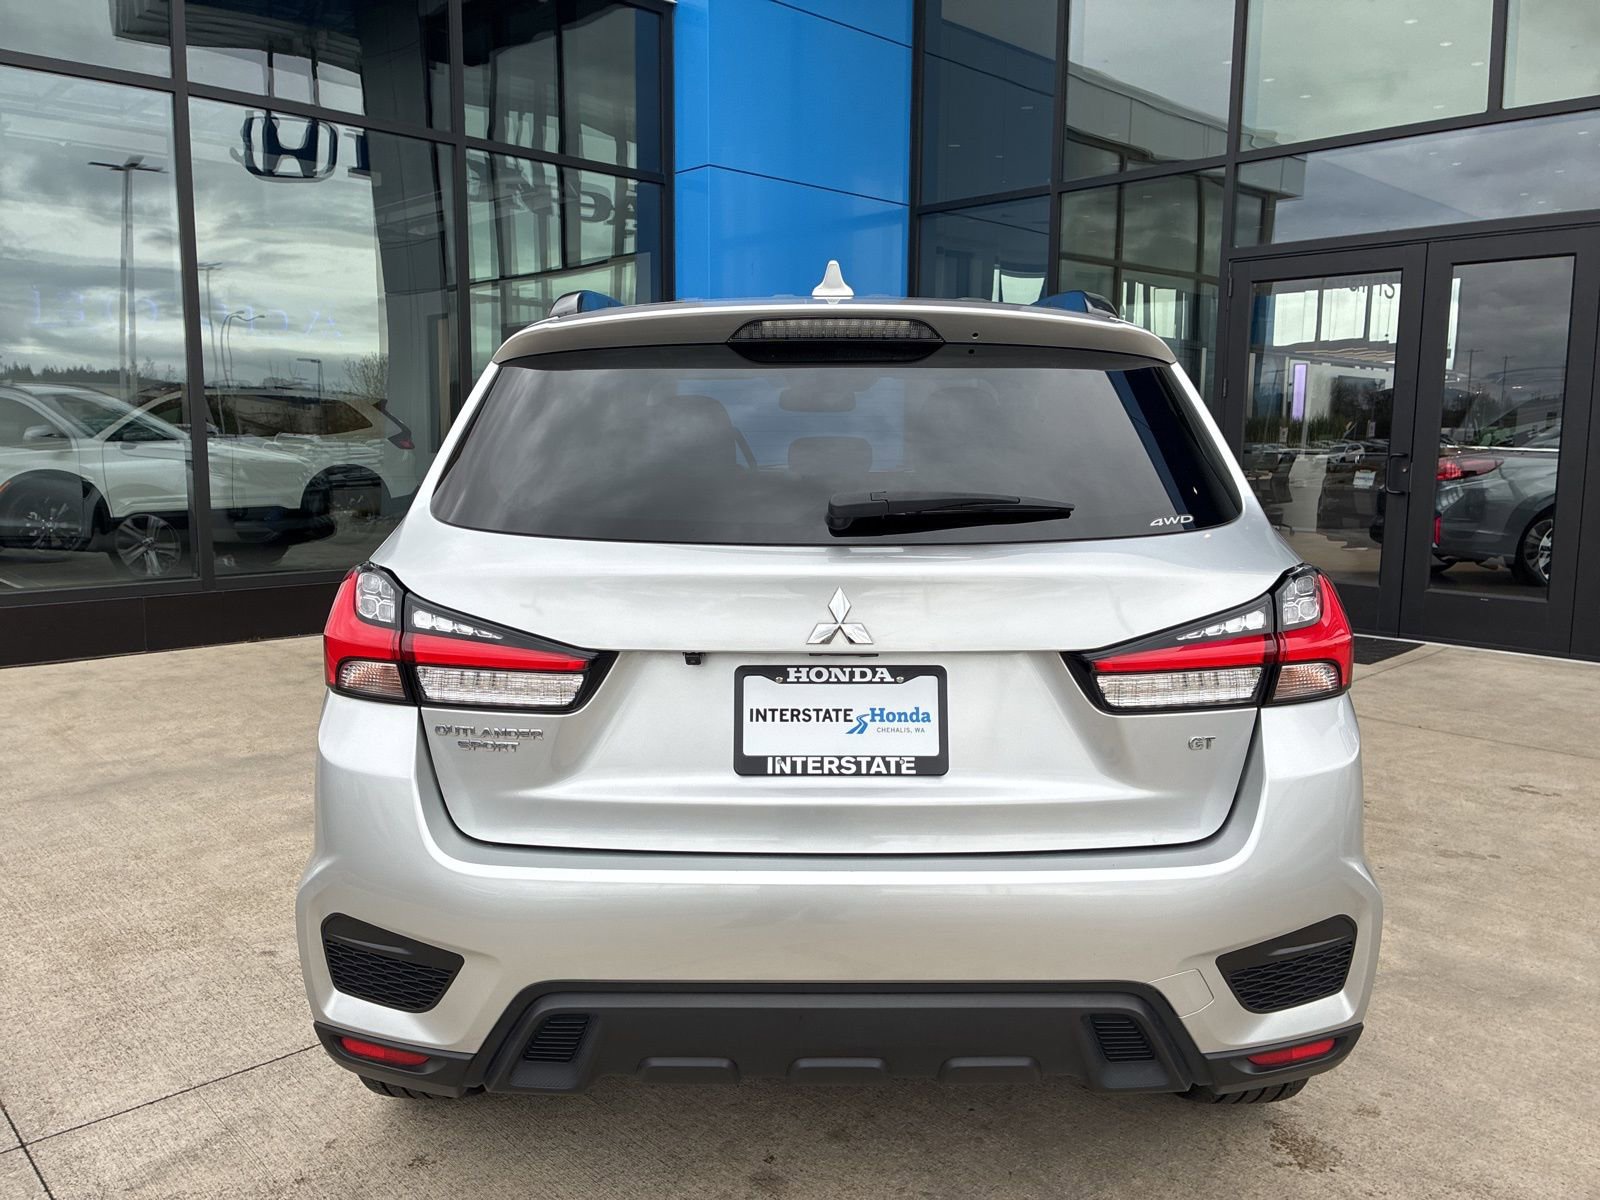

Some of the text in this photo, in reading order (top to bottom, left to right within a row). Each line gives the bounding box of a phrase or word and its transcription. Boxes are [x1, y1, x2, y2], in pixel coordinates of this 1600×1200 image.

[1150, 515, 1194, 526] 4WD
[787, 667, 894, 683] HONDA
[749, 707, 931, 723] INTERSTATE Honda
[434, 724, 544, 740] OUTLANDER
[457, 740, 519, 752] SPORT
[1188, 735, 1216, 751] GT
[767, 757, 916, 775] INTERSTATE
